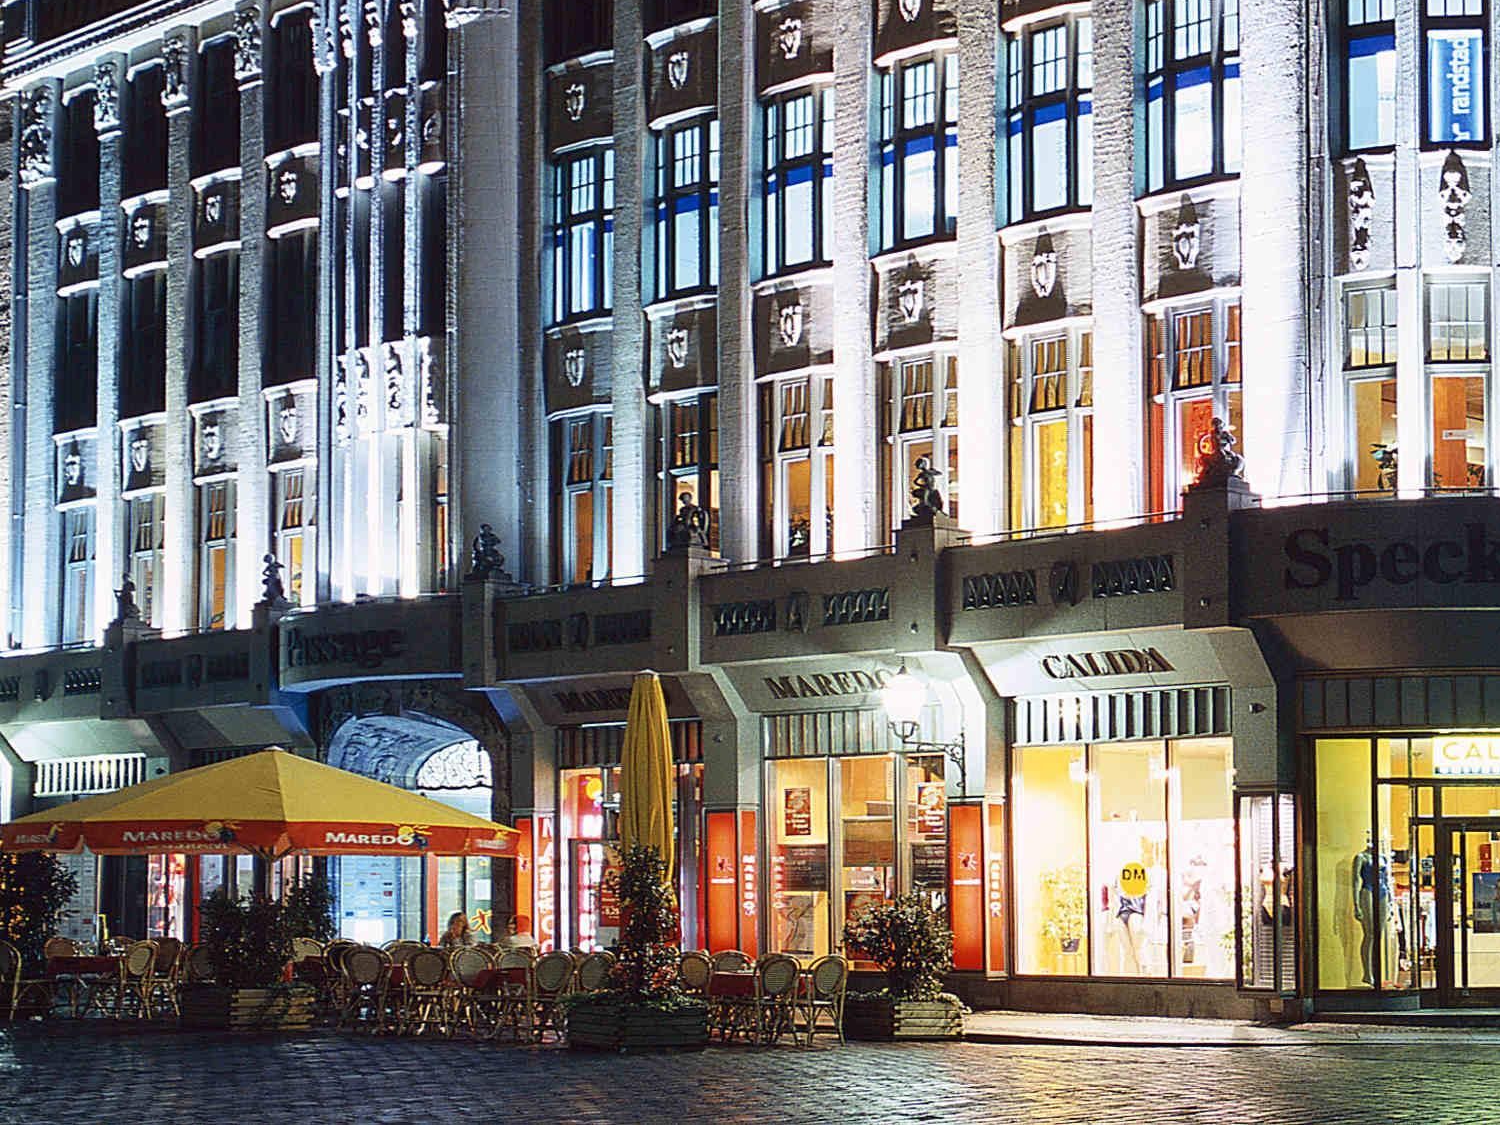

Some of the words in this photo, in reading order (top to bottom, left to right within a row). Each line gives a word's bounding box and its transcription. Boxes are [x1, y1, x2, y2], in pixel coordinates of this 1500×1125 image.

[1446, 37, 1472, 115] randstad
[1041, 647, 1177, 680] CALIDA
[122, 830, 221, 843] MAREDO
[324, 832, 415, 846] MAREDO
[1121, 868, 1146, 881] DM
